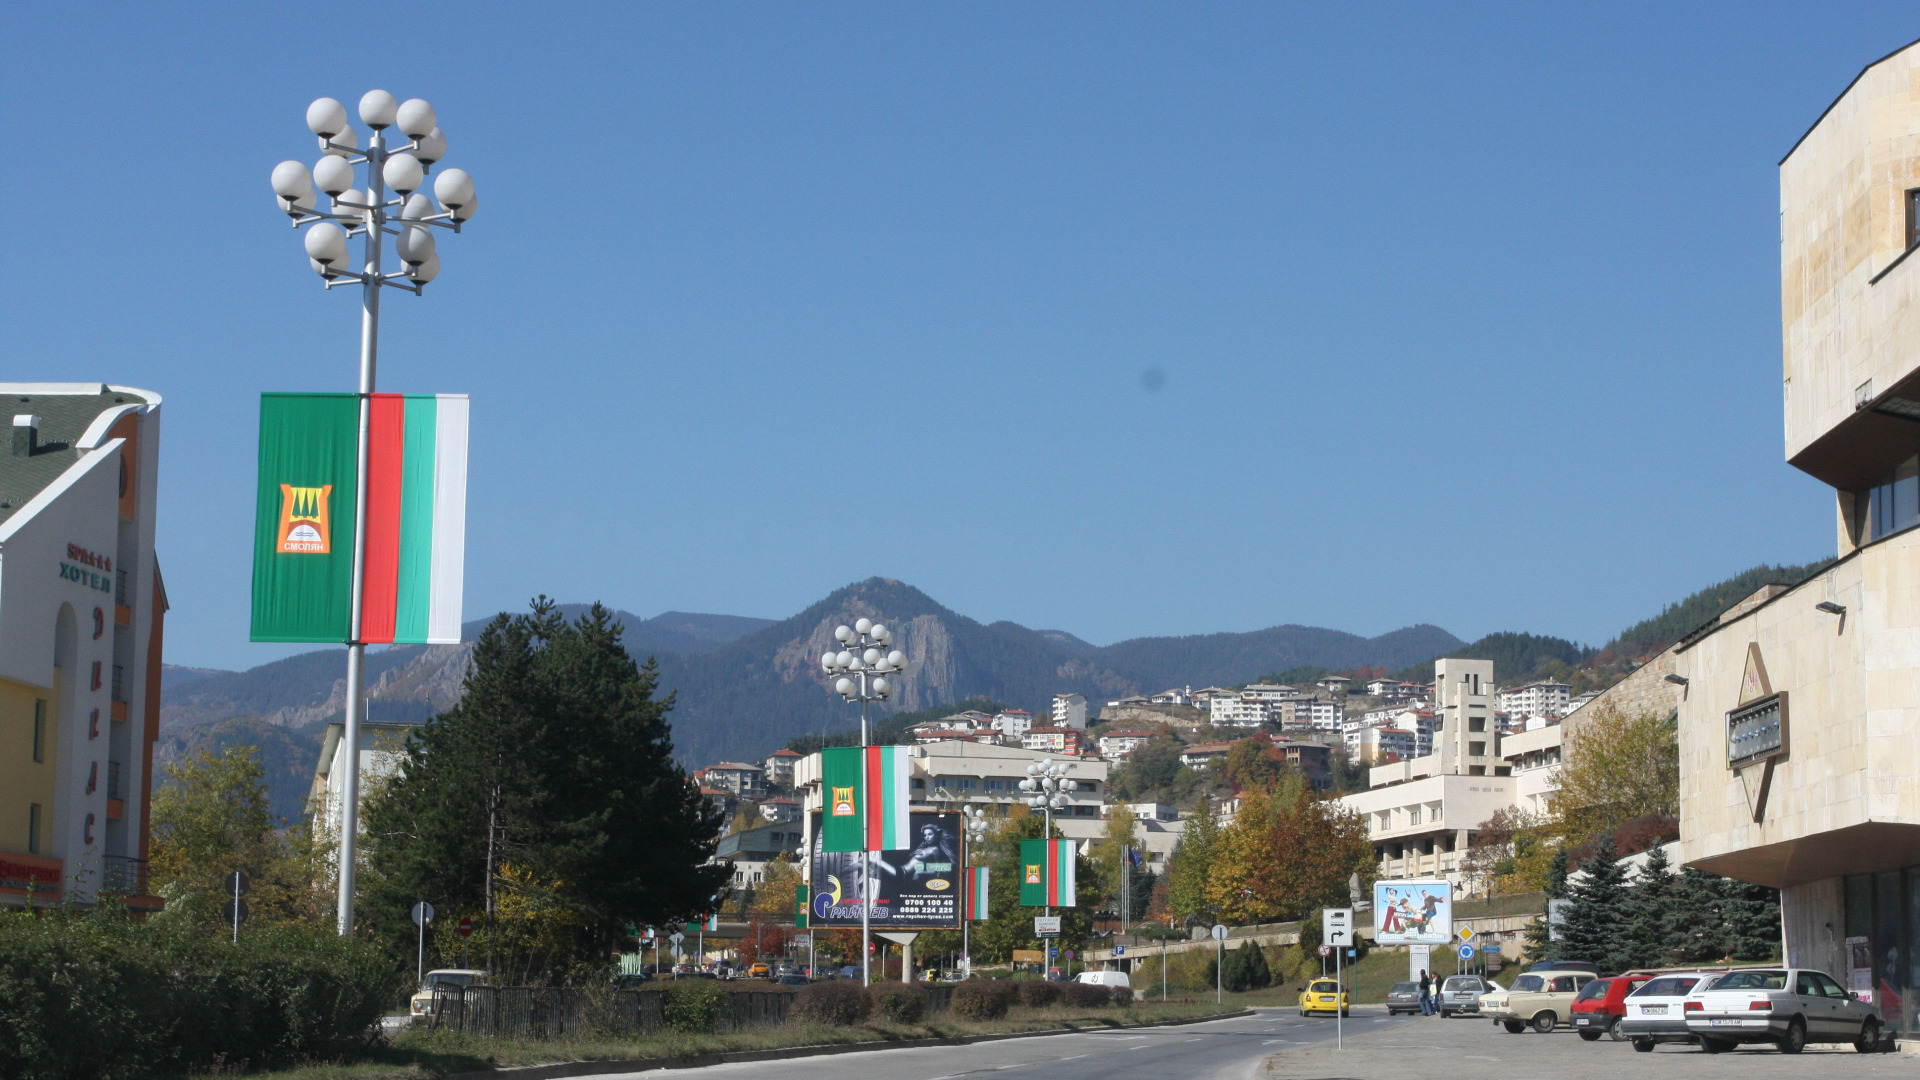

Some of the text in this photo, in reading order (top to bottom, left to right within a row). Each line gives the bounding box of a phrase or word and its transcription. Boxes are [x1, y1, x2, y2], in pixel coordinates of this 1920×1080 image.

[67, 543, 89, 564] SPA
[284, 543, 324, 551] СМОЛЯН
[59, 562, 111, 593] ХОТЕЛ
